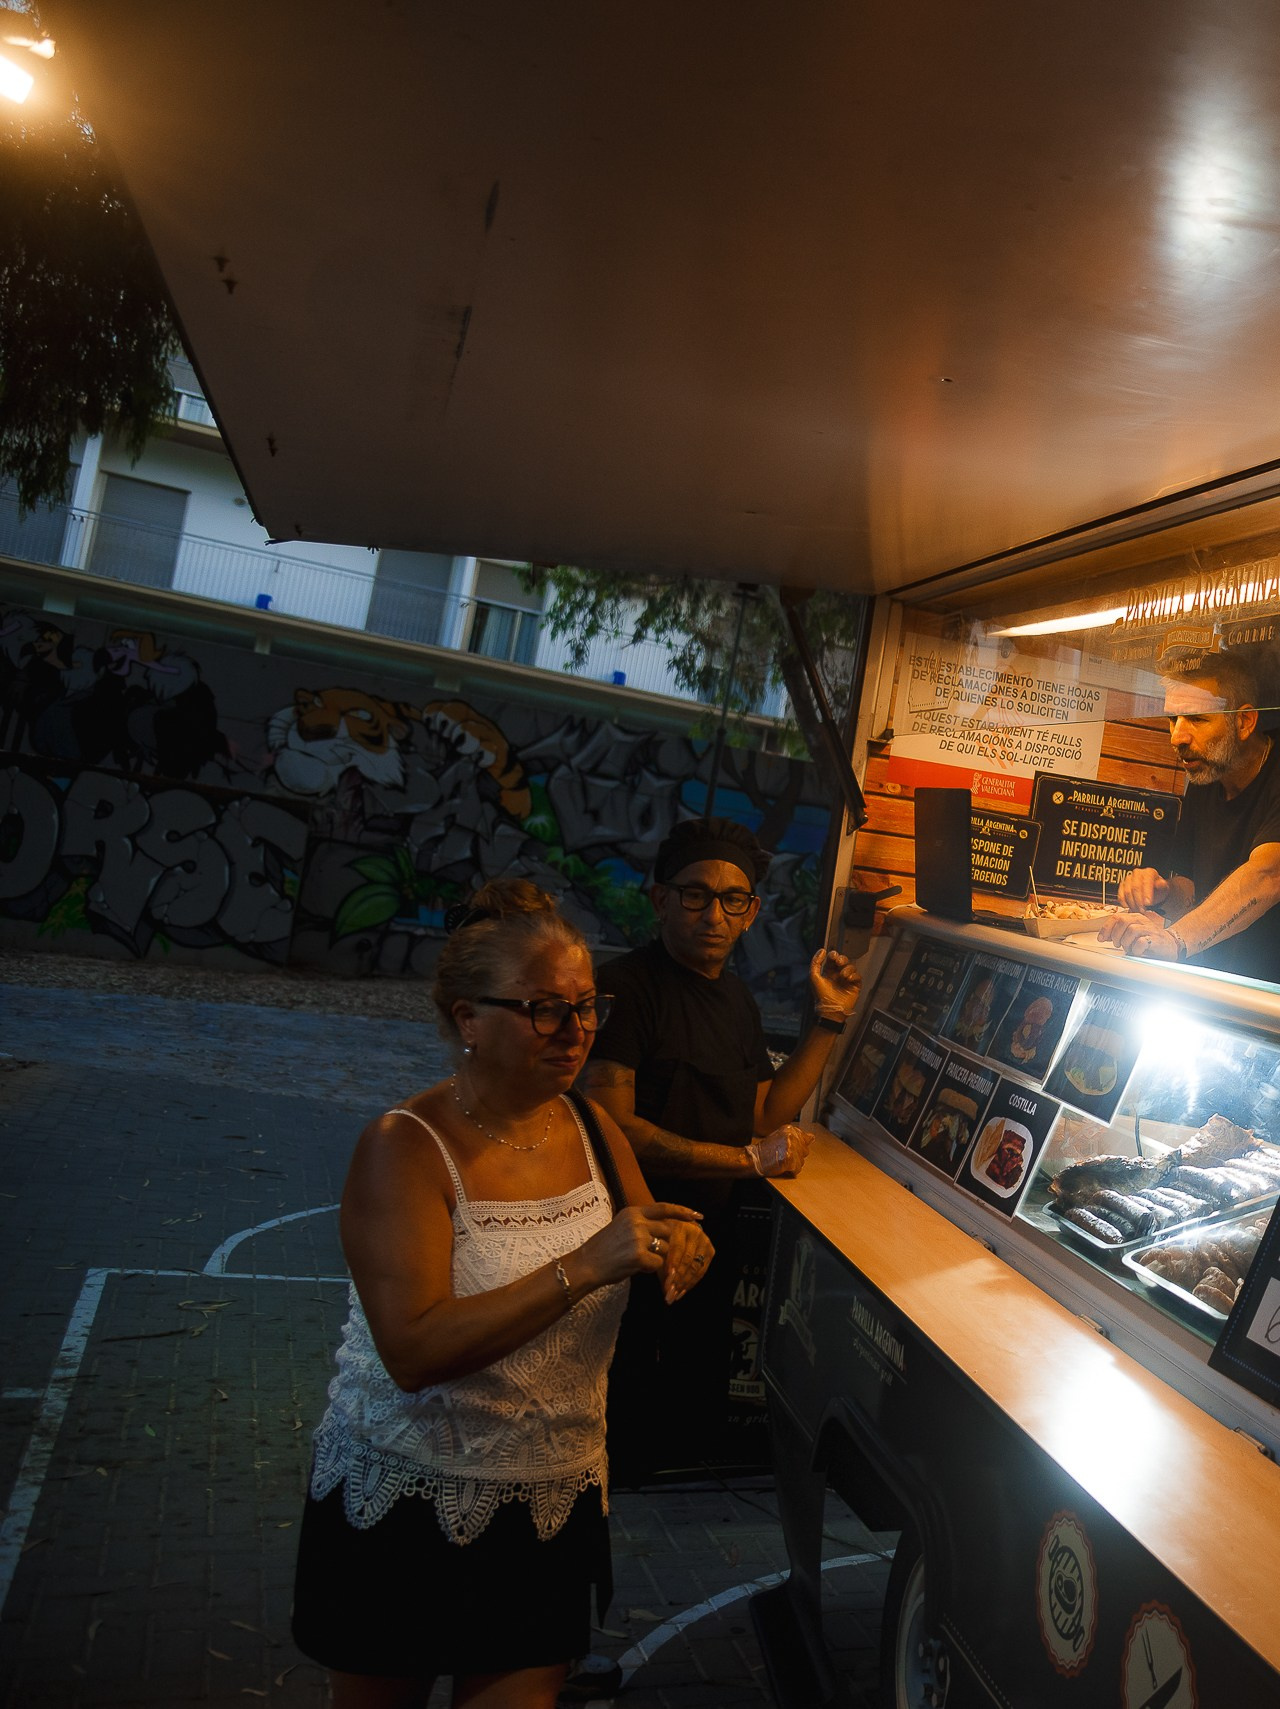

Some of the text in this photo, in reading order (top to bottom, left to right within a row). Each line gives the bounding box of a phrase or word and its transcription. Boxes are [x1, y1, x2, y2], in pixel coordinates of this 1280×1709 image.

[912, 669, 1094, 713] DE RECLAMACIONES A DISPOSICIÓN
[940, 660, 1034, 688] ESTABLECIMIENTO
[1036, 680, 1066, 694] TIENE
[1067, 686, 1100, 701] HOJAS
[935, 686, 1069, 721] DE QUIENES LO SOLICITEN
[912, 721, 928, 733] DE
[1014, 740, 1022, 751] A
[1025, 741, 1082, 761] DISPOSICIÓ
[915, 711, 1083, 748] AQUEST ESTABLIMENT TÉ FULLS
[939, 739, 1056, 769] DE QUI ELS SOL-LICITE
[981, 776, 1016, 788] GENERALITAT
[981, 784, 1015, 797] VALENCIANA
[1072, 790, 1105, 806] PARRILLA
[1107, 796, 1146, 813] ARGENTINA
[1062, 819, 1148, 847] SE DISPONE DE
[971, 853, 1011, 872] RMACIÓN
[1002, 845, 1015, 858] DE
[1060, 840, 1143, 867] INFORMACIÓN
[1055, 860, 1133, 884] DE ALÉRGEN
[1028, 968, 1055, 988] BURGER
[1008, 1093, 1038, 1116] COSTILLA
